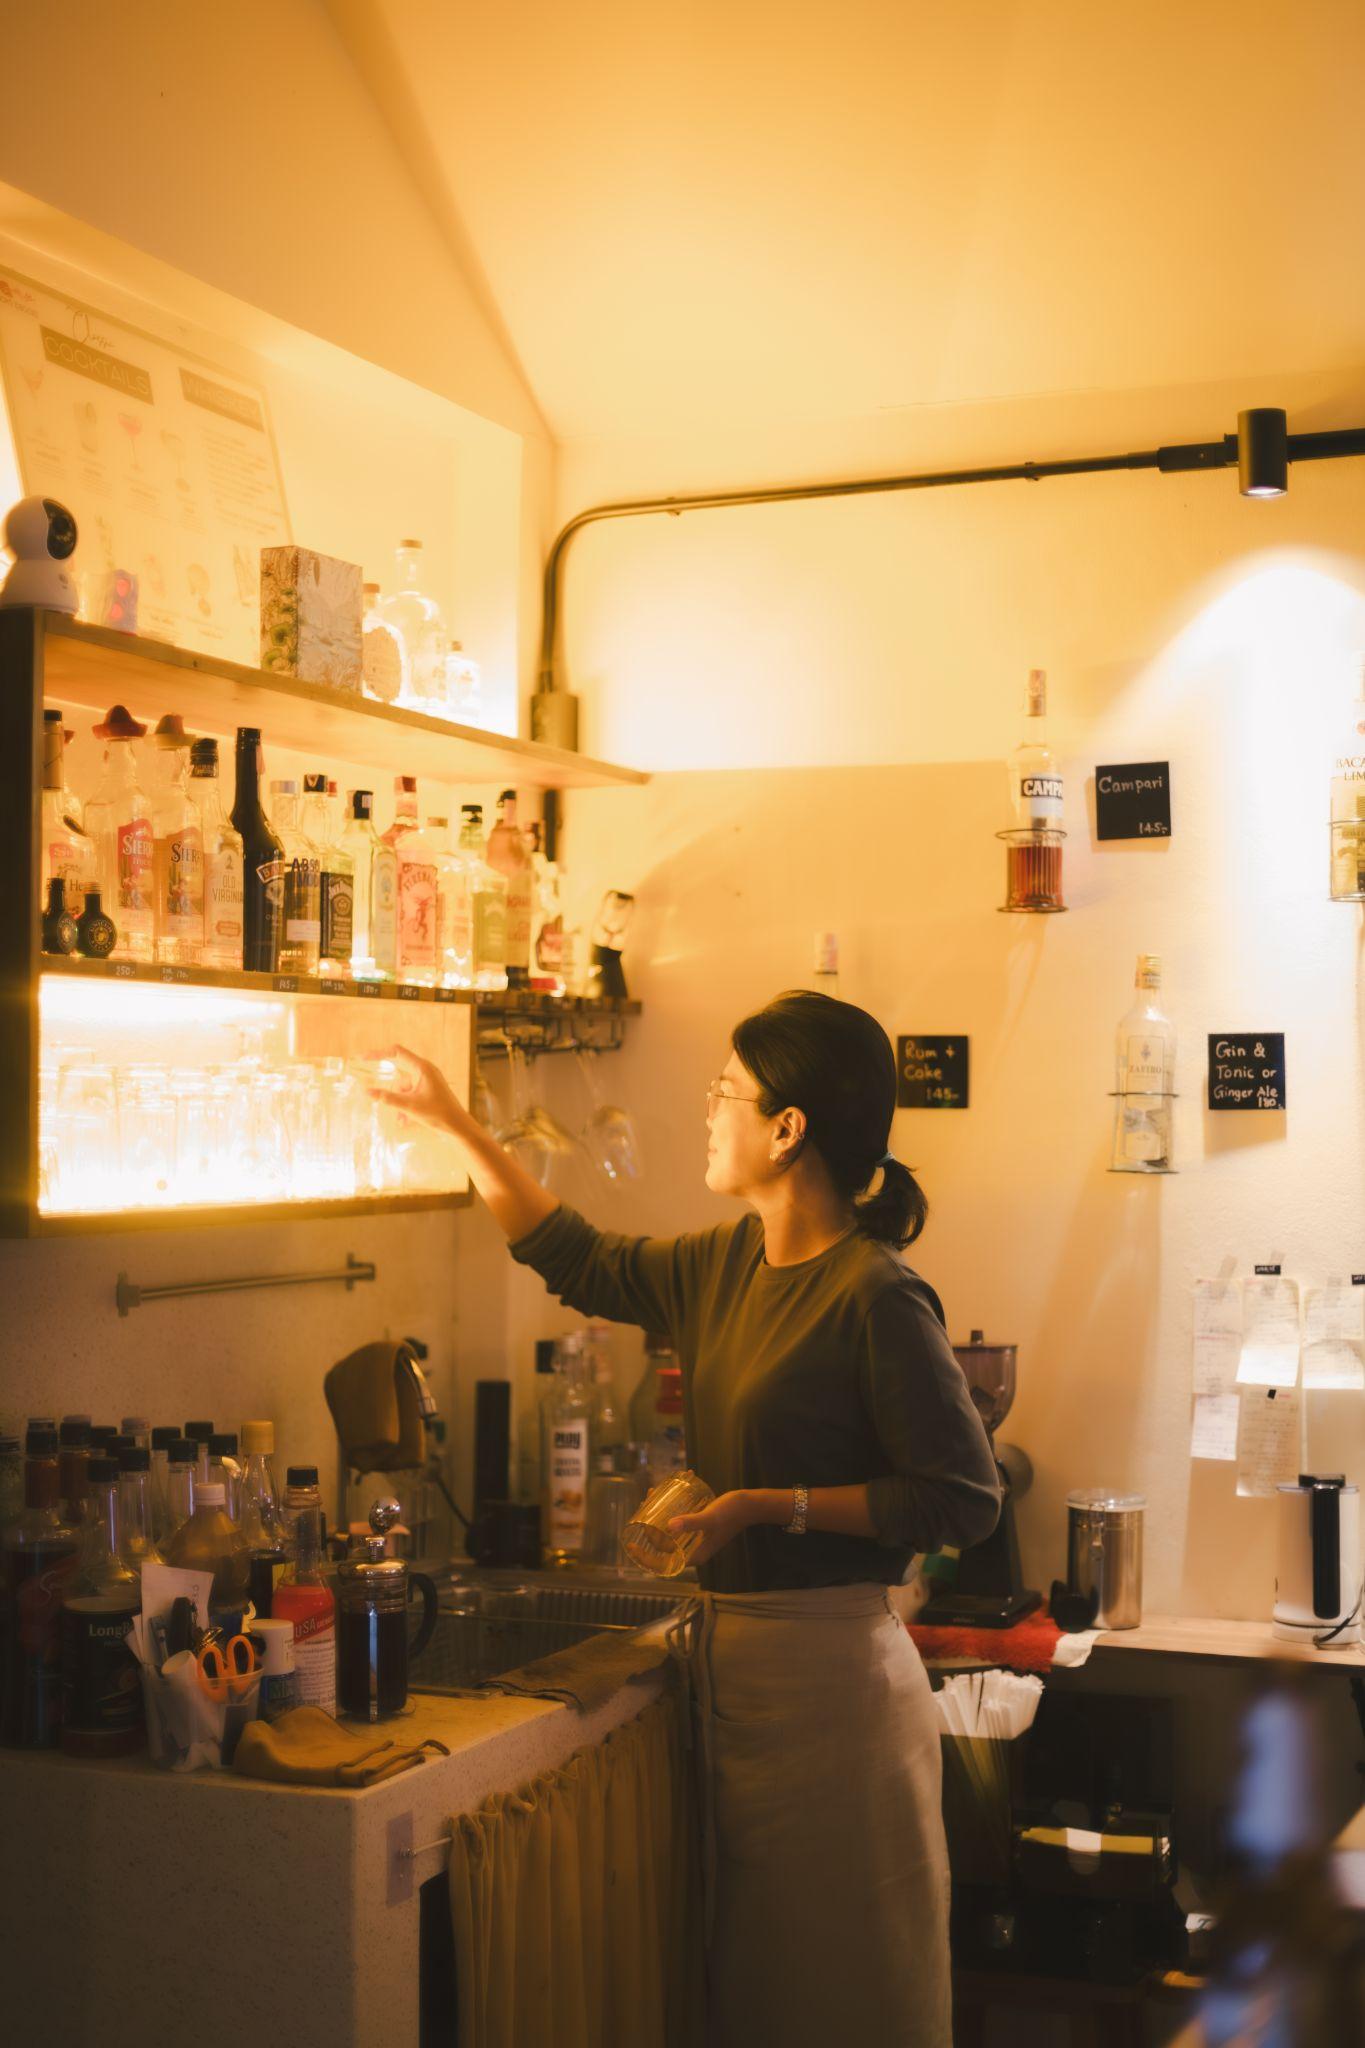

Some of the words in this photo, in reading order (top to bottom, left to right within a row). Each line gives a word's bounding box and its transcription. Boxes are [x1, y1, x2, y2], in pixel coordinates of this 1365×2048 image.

[44, 336, 150, 396] COCKTAILS
[1099, 776, 1162, 794] Campari
[905, 1040, 937, 1060] Rum
[1216, 1041, 1246, 1058] Gin
[1254, 1041, 1266, 1058] &
[904, 1063, 942, 1081] Coke
[1216, 1065, 1254, 1079] Tonic
[1262, 1069, 1277, 1079] or
[1213, 1084, 1253, 1102] Ginger
[1256, 1085, 1279, 1098] Ale
